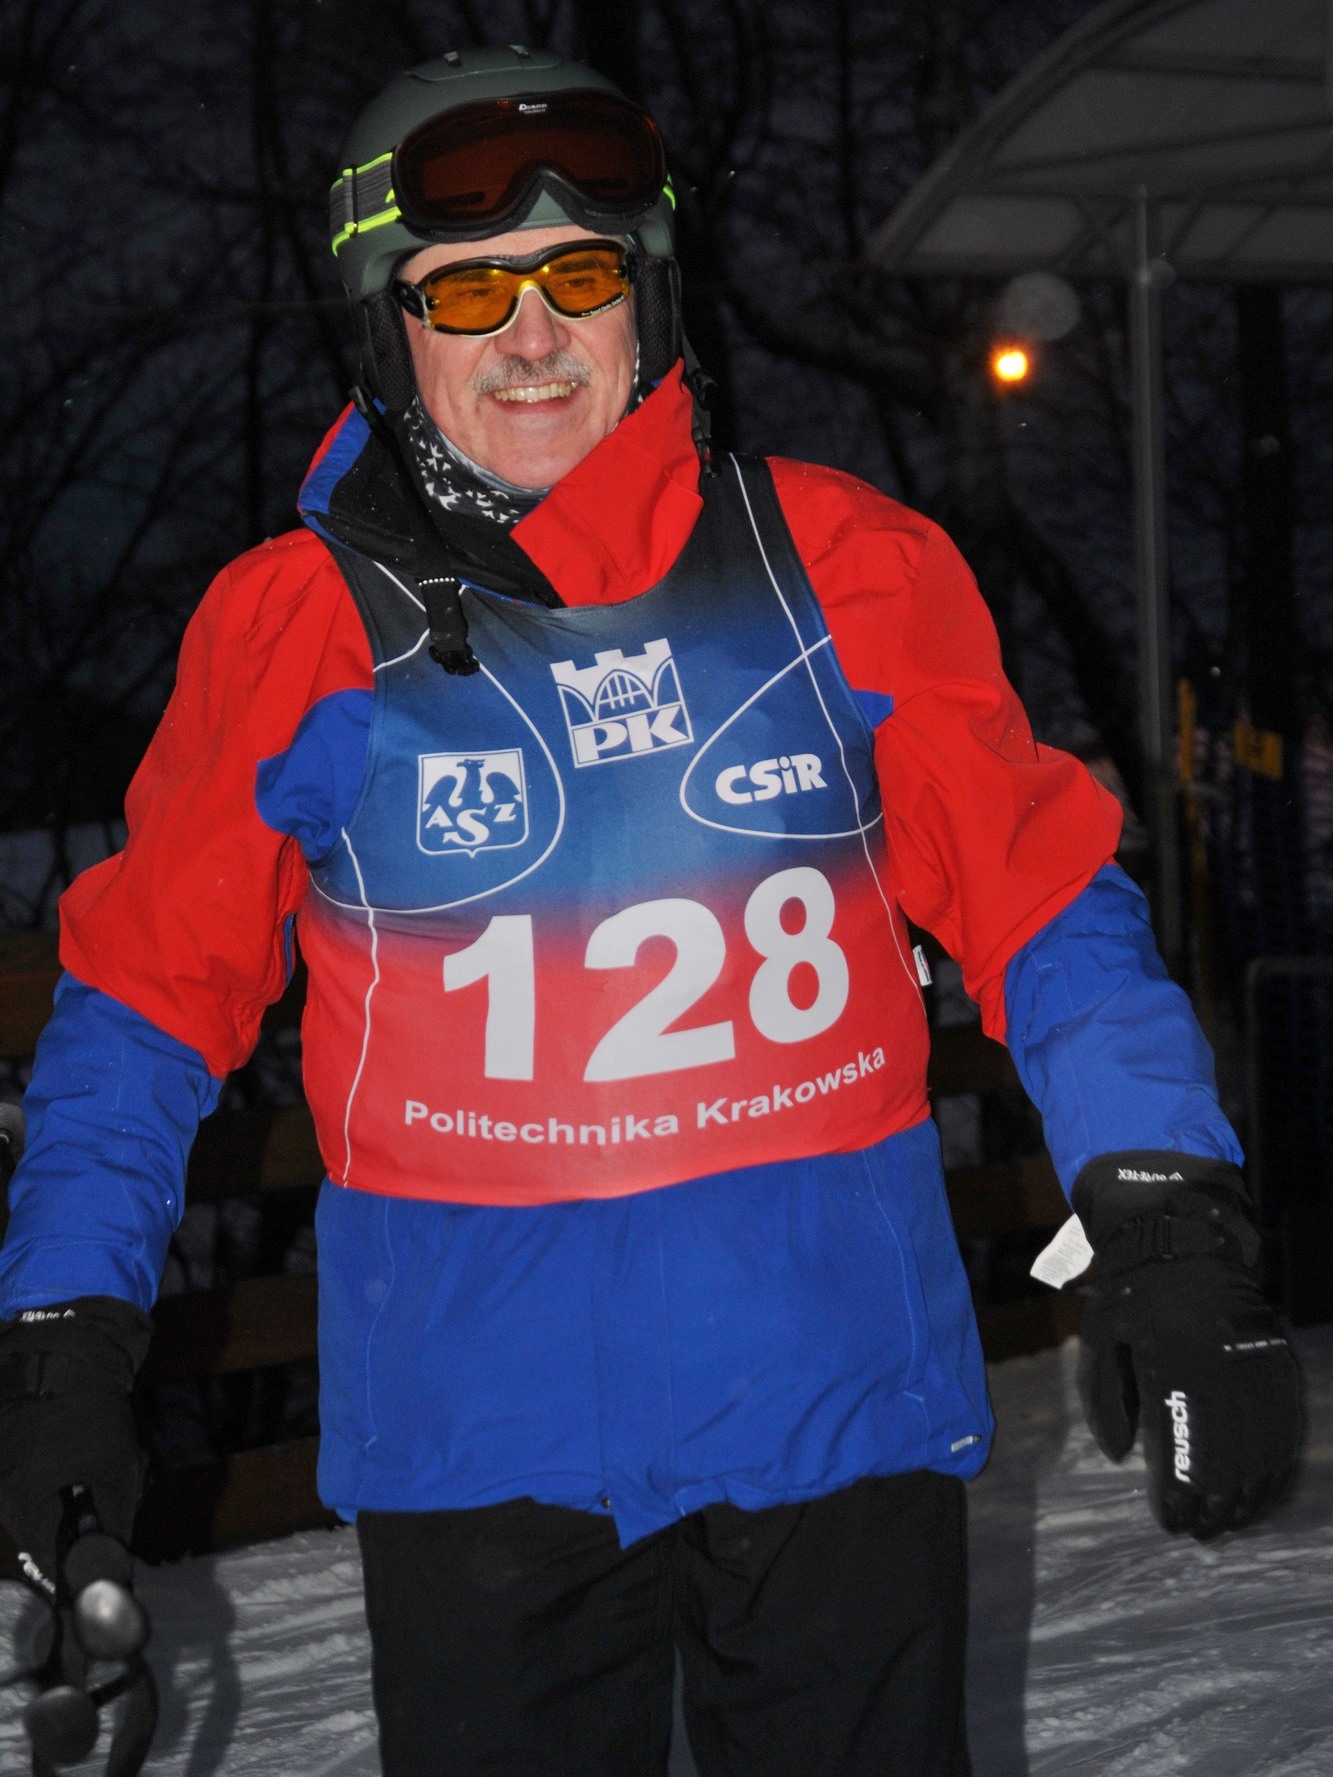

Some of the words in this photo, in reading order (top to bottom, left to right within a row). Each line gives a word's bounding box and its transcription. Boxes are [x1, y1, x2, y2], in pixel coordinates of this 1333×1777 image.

[573, 703, 690, 763] PK
[443, 866, 850, 1083] 128
[404, 1099, 680, 1146] Politechnika
[697, 1046, 886, 1129] Krakowska
[1164, 1390, 1192, 1484] reusch
